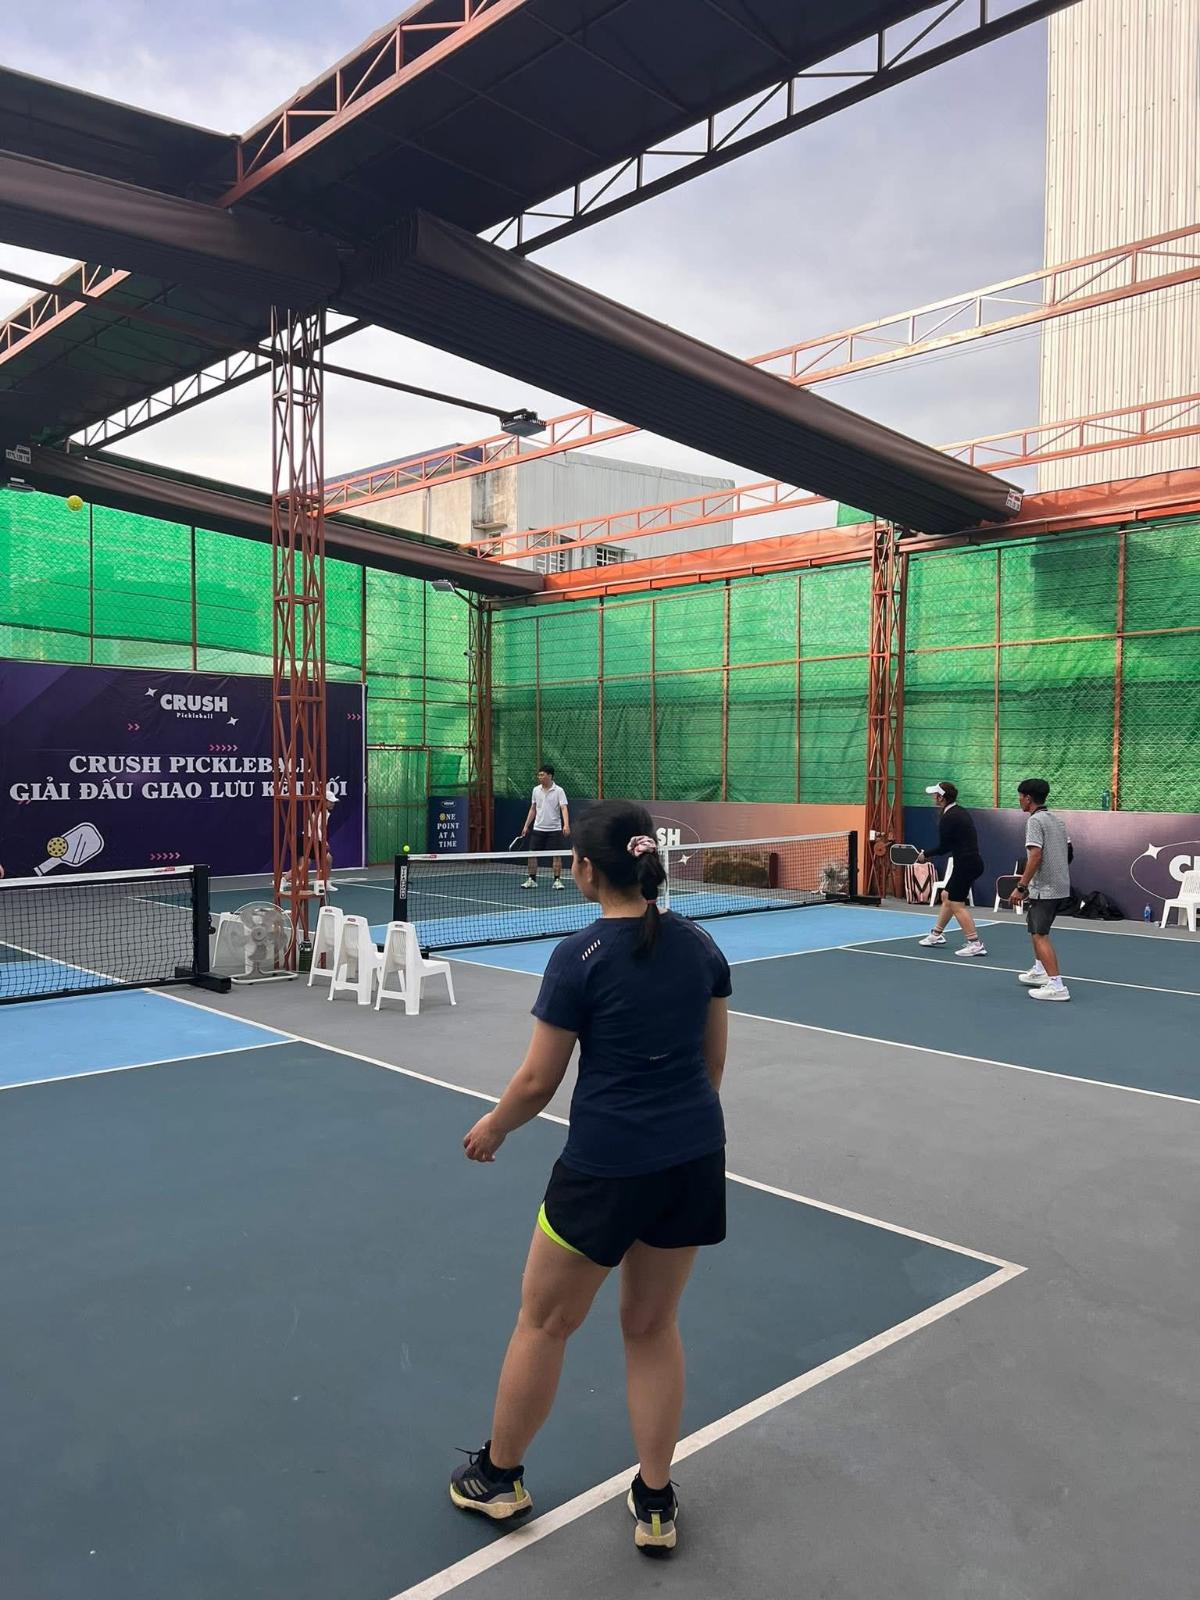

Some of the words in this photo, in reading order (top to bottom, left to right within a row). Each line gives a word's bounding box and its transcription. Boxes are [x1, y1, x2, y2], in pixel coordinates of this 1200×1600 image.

[160, 693, 228, 712] CRUSH
[69, 755, 161, 773] CRUSH
[9, 776, 71, 801] GIẢI
[79, 776, 134, 800] ĐẤU
[141, 782, 202, 799] GIAO
[210, 780, 255, 798] LƯU
